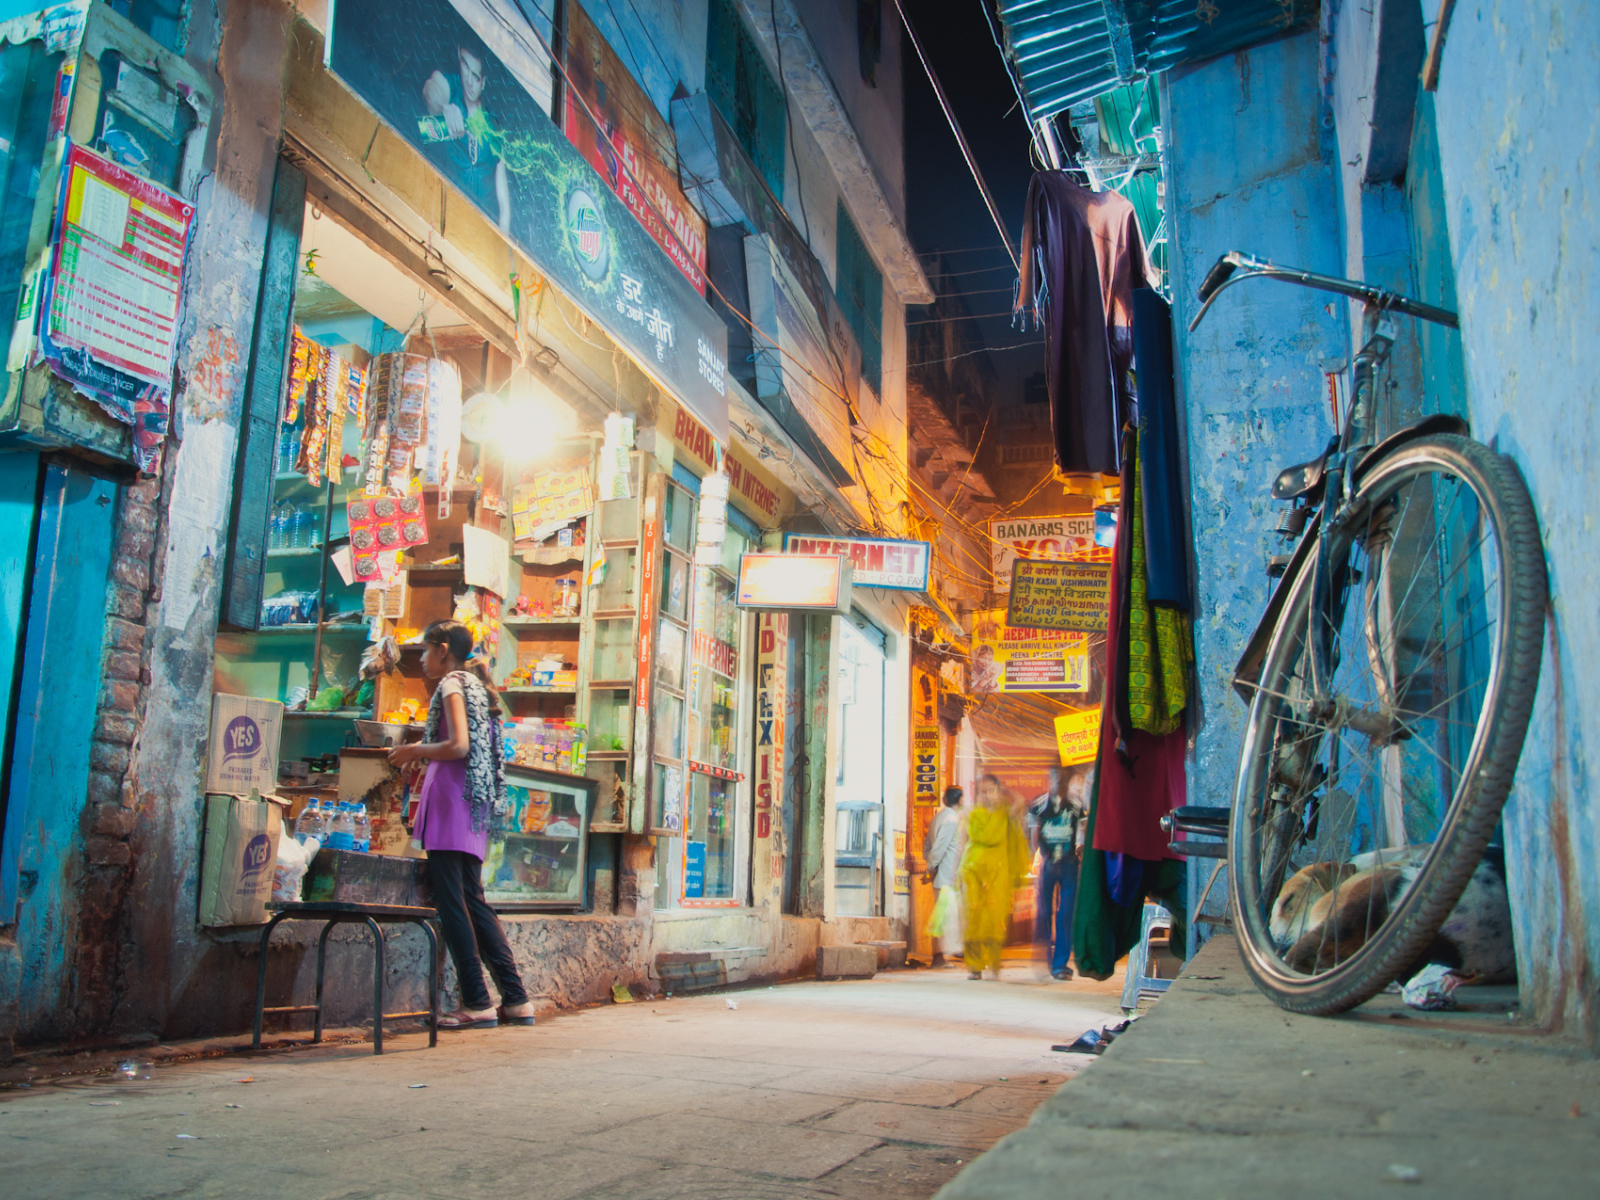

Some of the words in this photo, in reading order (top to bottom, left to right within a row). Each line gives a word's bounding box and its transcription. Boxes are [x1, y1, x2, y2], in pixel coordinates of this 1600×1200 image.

[622, 184, 647, 221] FULL
[647, 214, 671, 249] FULL
[671, 244, 702, 287] MASALA
[620, 272, 643, 305] डर
[645, 308, 674, 348] जीत
[697, 338, 725, 378] SANJAY
[698, 358, 725, 397] STORES
[675, 408, 742, 490] BHAVSH
[742, 468, 781, 518] INTERNET
[997, 521, 1064, 539] BANARAS
[907, 576, 924, 585] FAX
[1017, 576, 1034, 585] SHRI
[1035, 577, 1057, 586] KASHI
[1060, 579, 1107, 588] VISHWANATH
[1021, 563, 1034, 576] श्री
[1035, 565, 1060, 577] काशी
[1003, 628, 1038, 641] HEENA
[1041, 629, 1083, 640] CENTRE
[1011, 651, 1030, 659] HEENA
[230, 725, 255, 750] YES
[915, 731, 938, 740] BANARAS
[915, 741, 938, 749] SCHOOL
[916, 754, 937, 793] YOGA
[757, 754, 772, 839] ISD
[249, 842, 268, 866] YES
